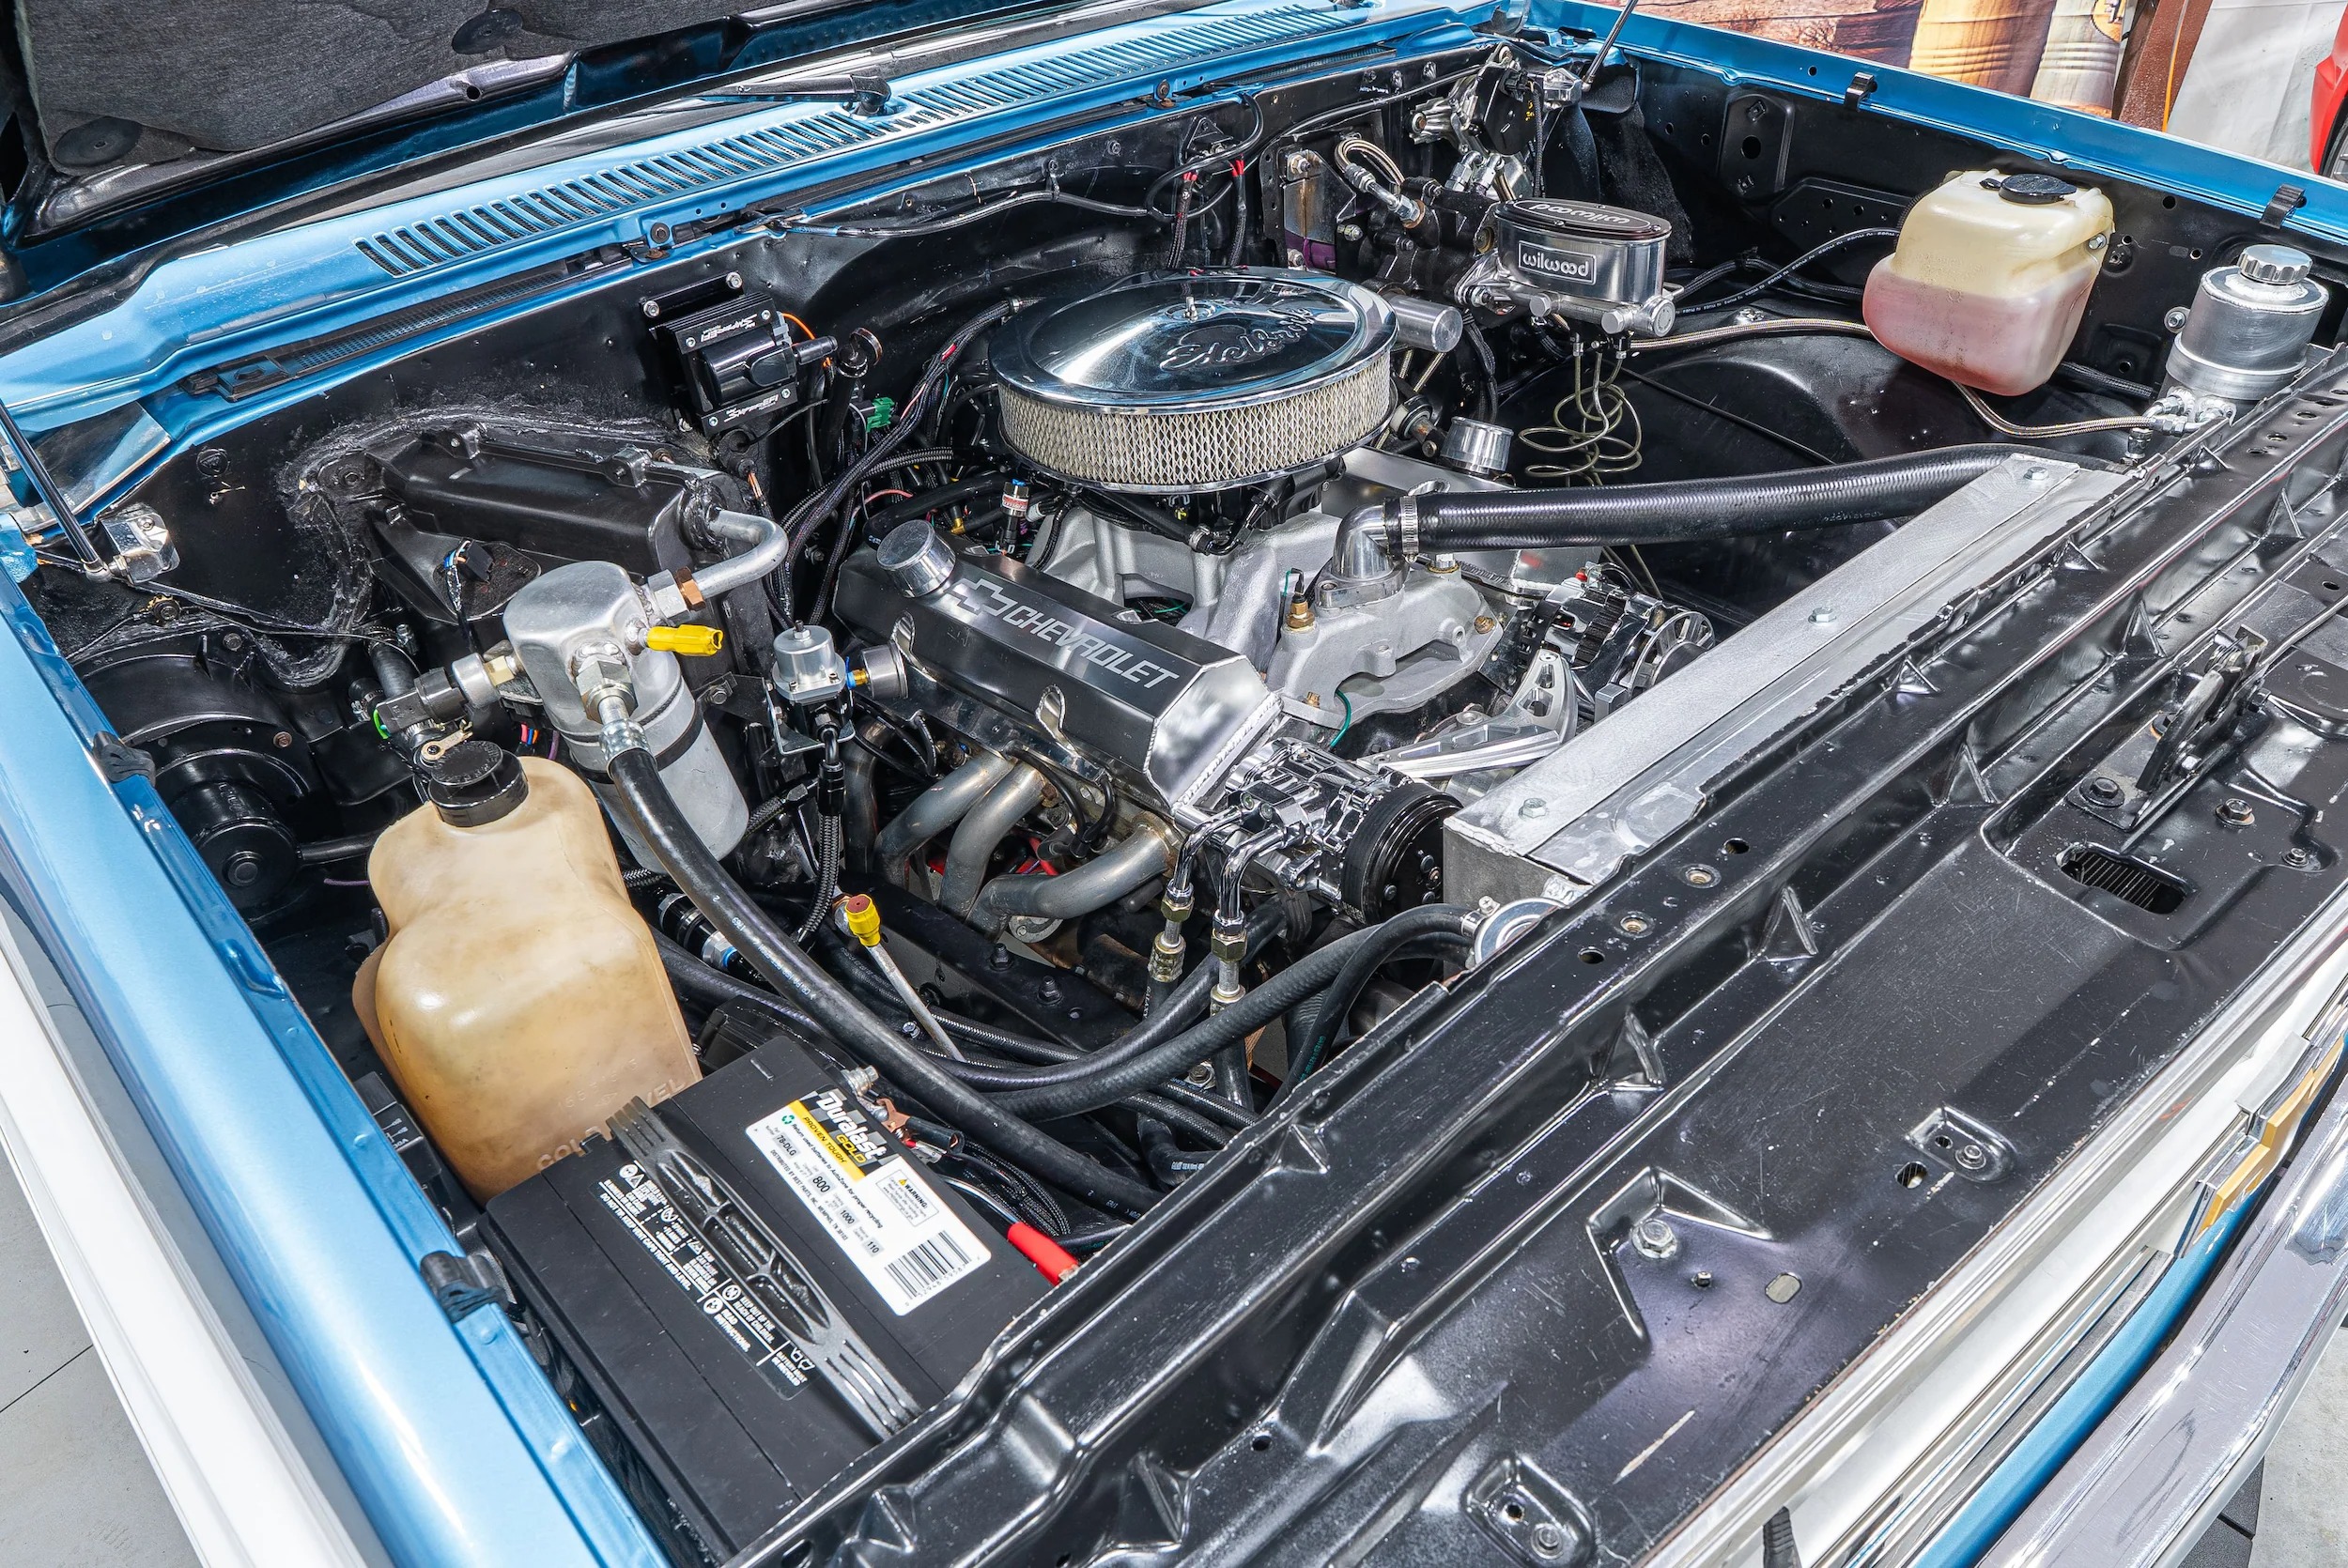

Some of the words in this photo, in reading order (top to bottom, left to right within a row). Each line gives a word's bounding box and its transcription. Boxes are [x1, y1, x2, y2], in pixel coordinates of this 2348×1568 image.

[1530, 203, 1630, 224] wilwood
[1522, 252, 1589, 277] wilwood
[1004, 604, 1180, 689] CHEVROLET
[816, 1091, 888, 1161] Duralast
[775, 1134, 797, 1156] 78-DLG
[802, 1116, 827, 1143] PROVEN
[825, 1142, 847, 1163] TOUGH
[836, 1134, 867, 1164] GOLD
[769, 1149, 791, 1172] DISTRIBUTED
[811, 1175, 831, 1193] 800
[904, 1183, 929, 1208] WARNING:
[839, 1208, 856, 1224] 1000
[605, 1198, 619, 1211] NOT
[621, 1215, 637, 1230] KEEP
[631, 1226, 647, 1240] VENT
[641, 1237, 657, 1252] CAPS
[653, 1249, 670, 1265] TIGHT
[665, 1262, 679, 1275] AND
[865, 1240, 880, 1253] 110
[719, 1308, 739, 1326] READ
[732, 1299, 750, 1317] REACH
[738, 1295, 754, 1309] KEEP
[749, 1305, 762, 1317] OUT
